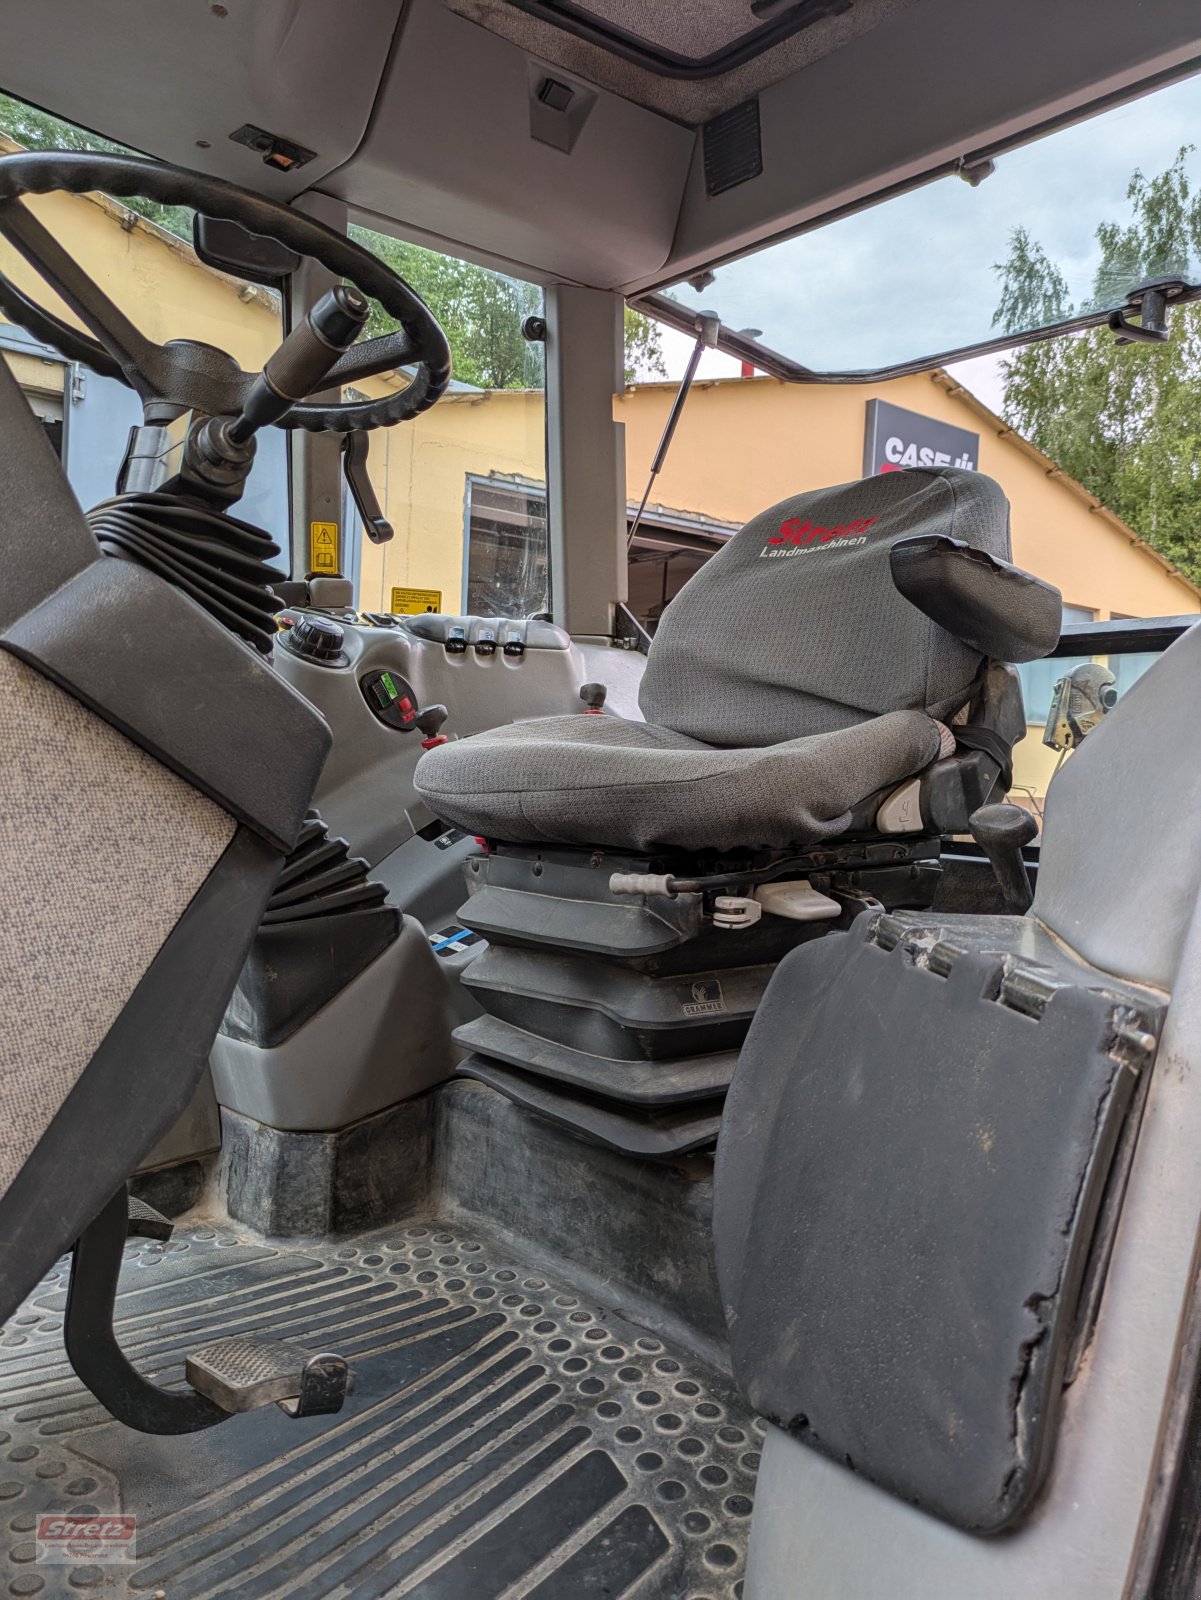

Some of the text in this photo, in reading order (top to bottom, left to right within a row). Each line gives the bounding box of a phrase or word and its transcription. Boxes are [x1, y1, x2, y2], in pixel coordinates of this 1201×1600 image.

[885, 437, 951, 467] CASE
[759, 536, 868, 558] Landmaschinen
[685, 1002, 722, 1014] GRAMMER
